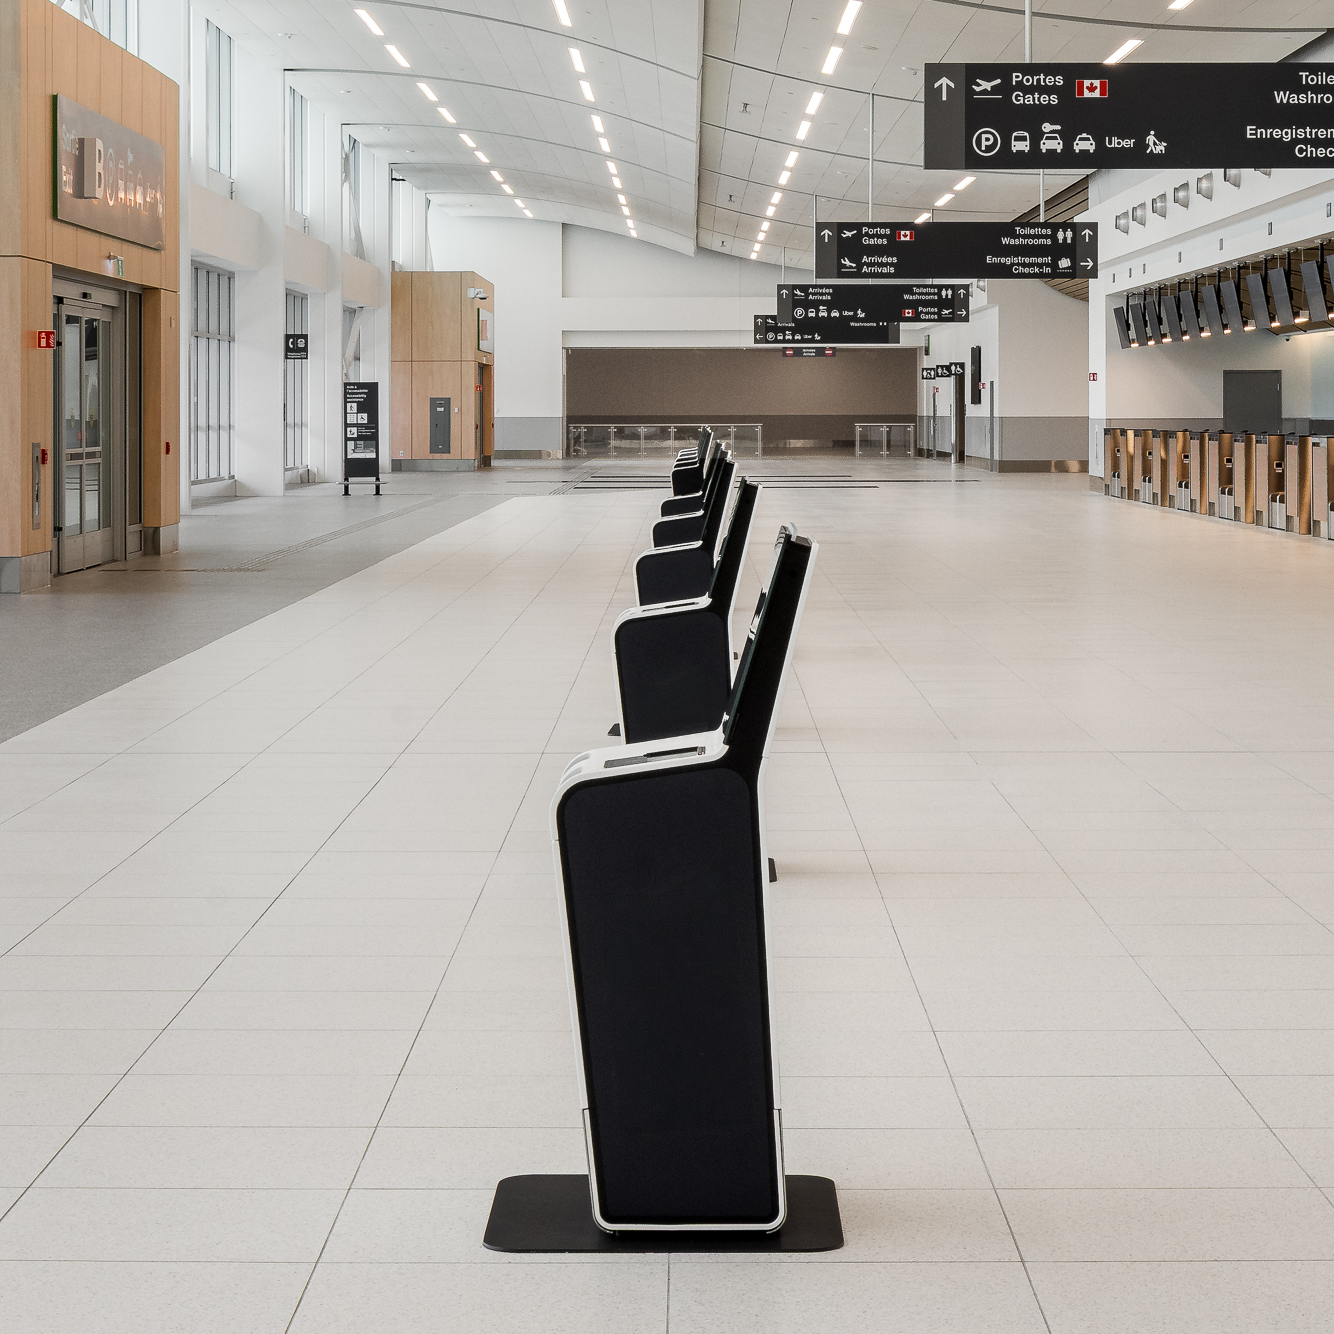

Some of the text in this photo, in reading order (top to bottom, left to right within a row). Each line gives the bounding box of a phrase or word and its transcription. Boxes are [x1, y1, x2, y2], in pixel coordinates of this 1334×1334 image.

[1012, 72, 1064, 86] Portes
[1012, 91, 1059, 105] Gates
[1105, 136, 1136, 148] Uber
[88, 137, 104, 199] B
[862, 226, 891, 235] Portes
[1014, 226, 1052, 235] Toilettes
[862, 236, 888, 245] Gates
[1001, 236, 1052, 245] Washrooms
[862, 254, 898, 263] Arrivées
[986, 255, 1052, 266] Enregistrement
[862, 265, 895, 274] Arrivals
[1012, 265, 1052, 274] Check-In
